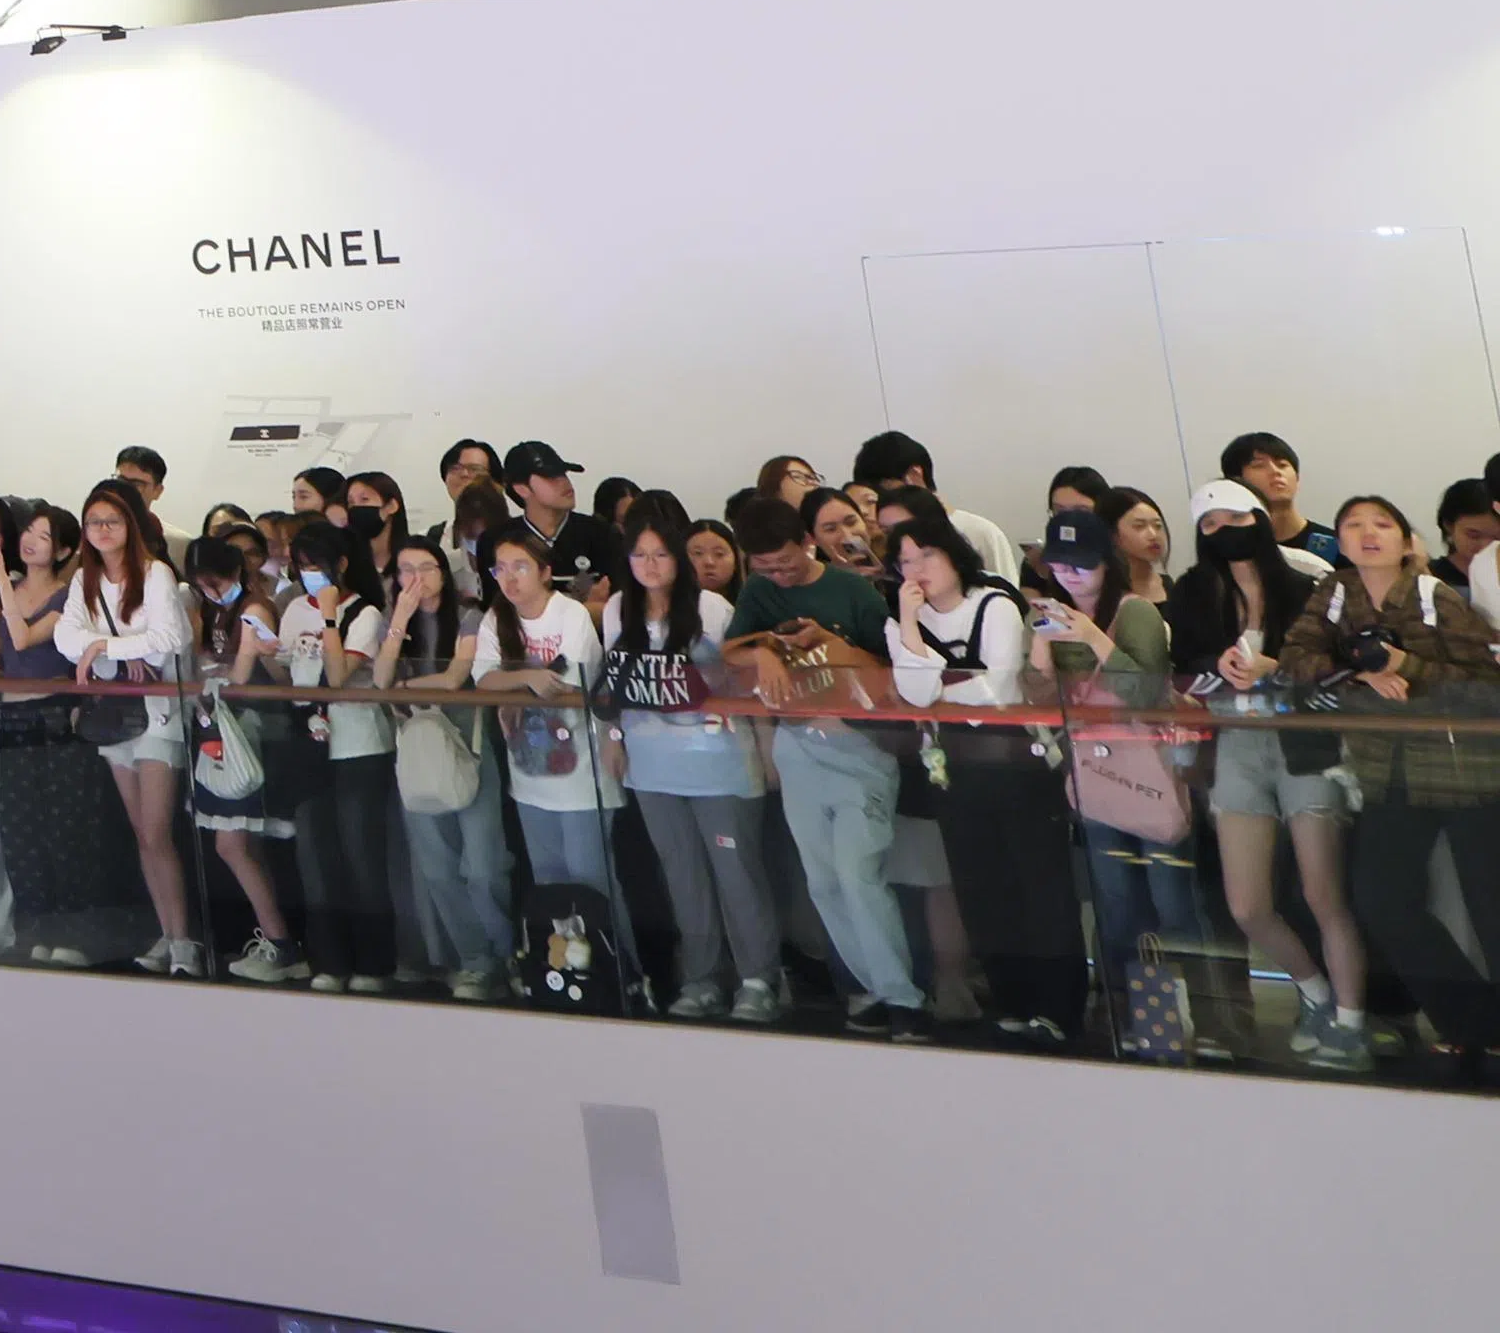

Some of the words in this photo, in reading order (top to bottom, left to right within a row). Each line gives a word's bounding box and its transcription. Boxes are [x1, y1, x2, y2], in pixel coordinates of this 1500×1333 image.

[192, 229, 401, 275] CHANEL
[198, 307, 224, 319] THE
[228, 303, 296, 318] BOUTIQUE
[300, 300, 363, 314] REMAINS
[366, 298, 406, 312] OPEN
